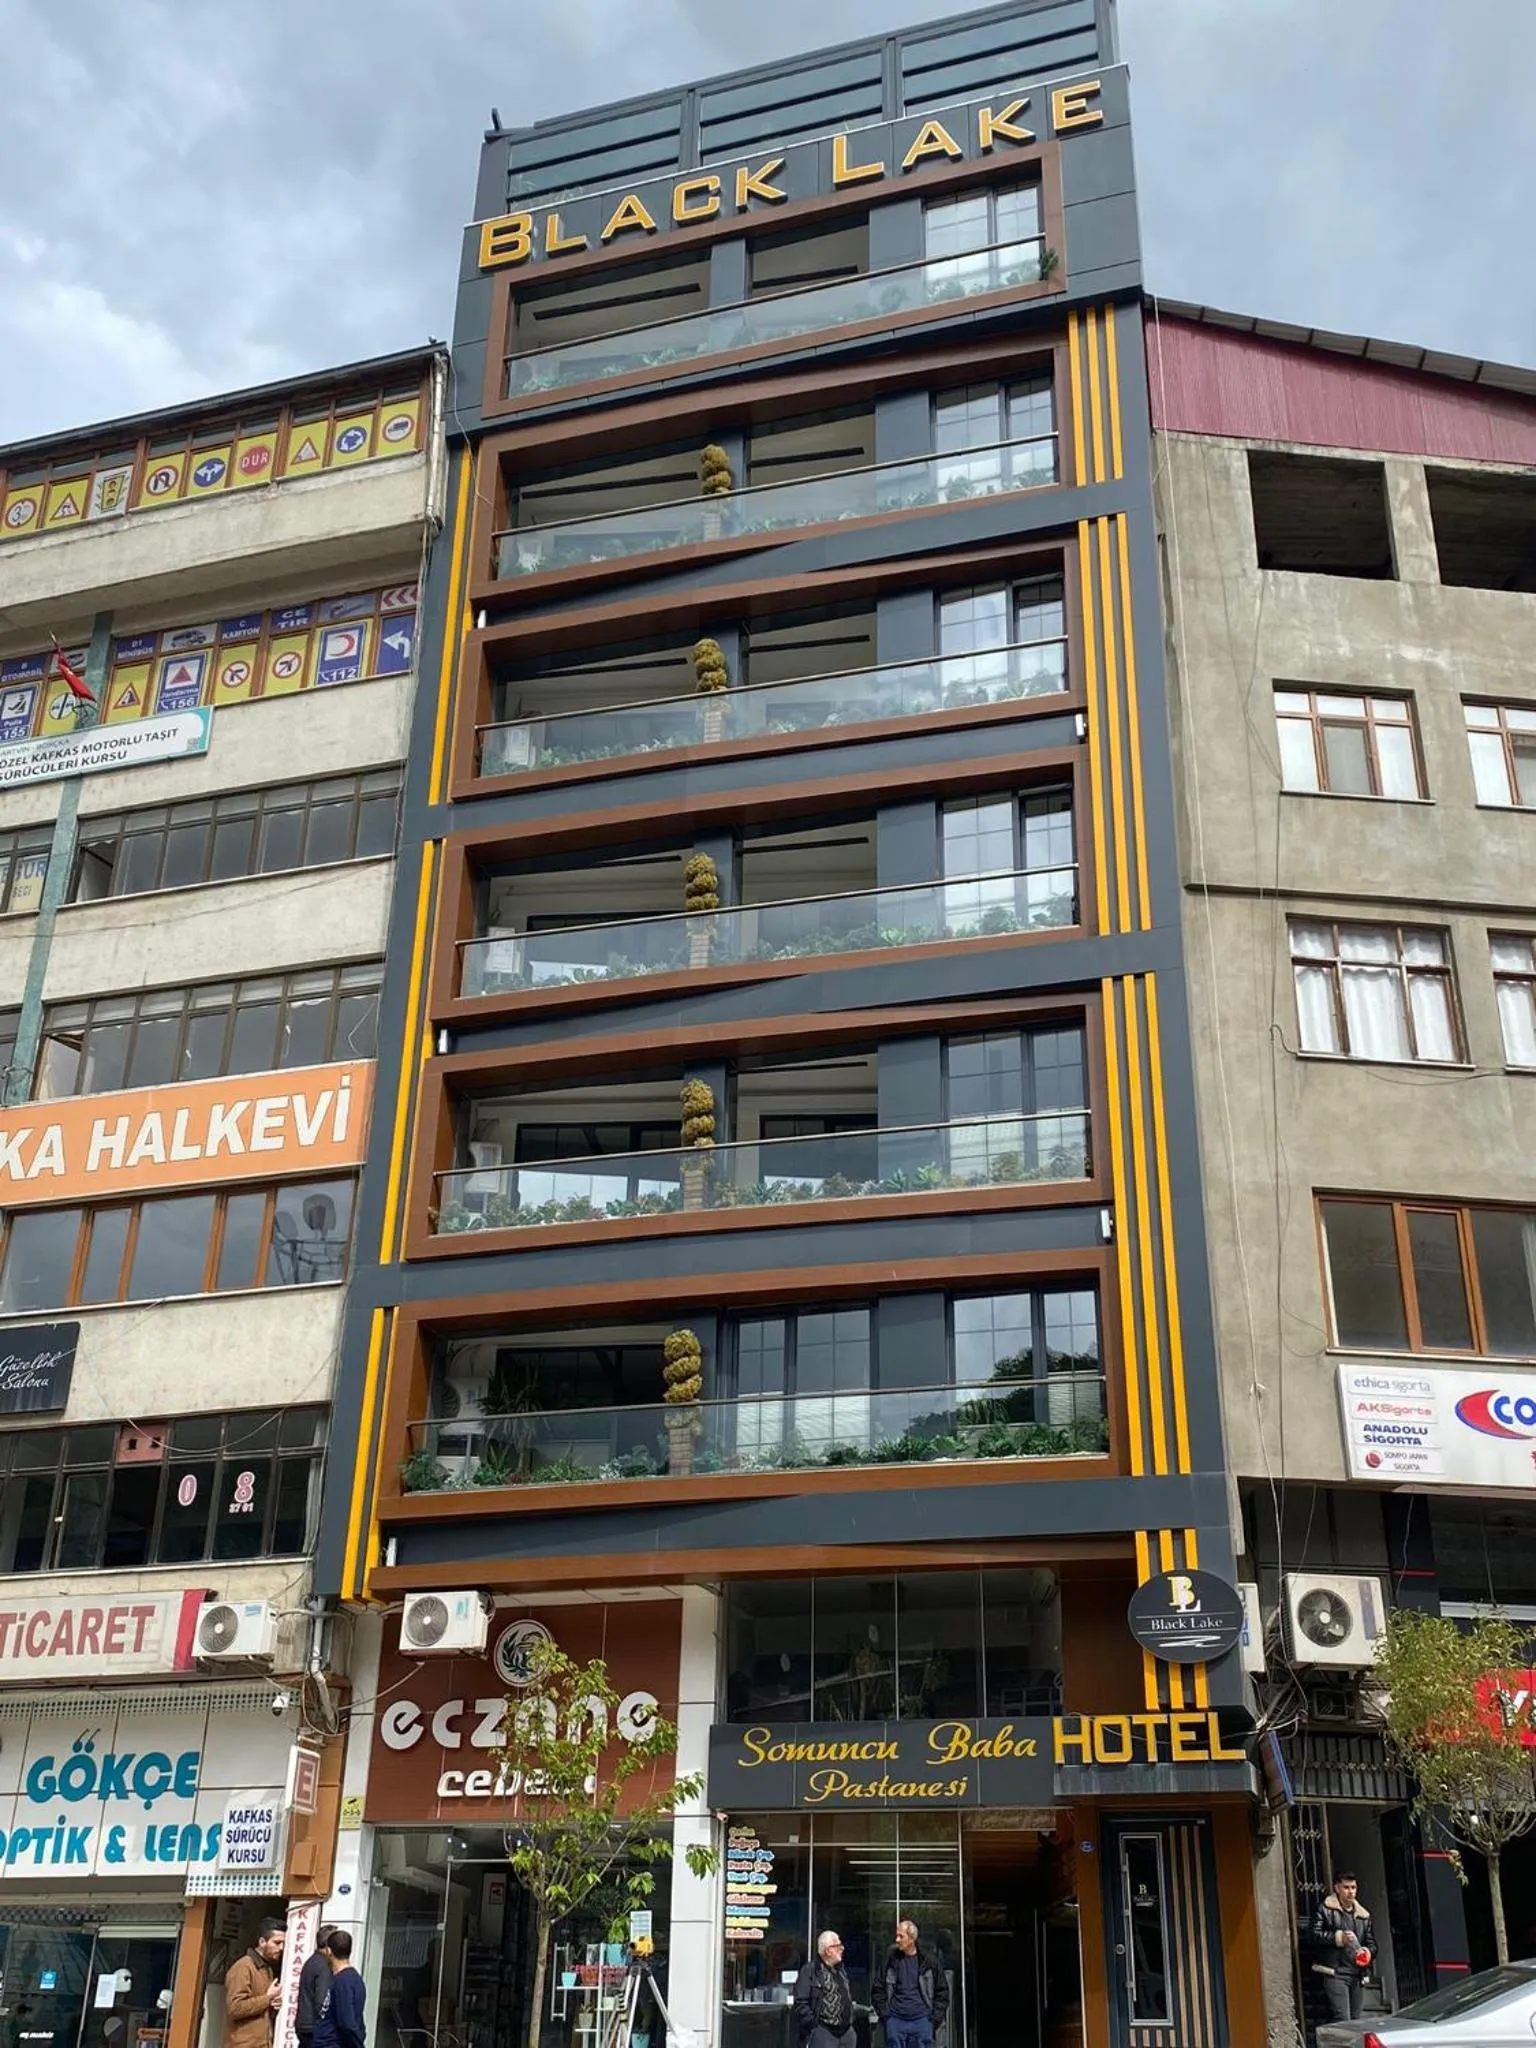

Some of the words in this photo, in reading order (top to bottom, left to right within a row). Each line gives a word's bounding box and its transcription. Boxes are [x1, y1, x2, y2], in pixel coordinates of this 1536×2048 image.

[478, 157, 788, 270] BLACK
[832, 79, 1105, 185] LAKE
[241, 451, 269, 468] DUR
[328, 670, 358, 682] 112
[169, 698, 196, 710] 156
[3, 728, 26, 740] 155
[31, 748, 79, 764] KAFKAS
[82, 736, 143, 755] MOTORLU
[144, 728, 178, 743] TAŞIT
[81, 750, 127, 767] KURSU
[86, 1073, 353, 1172] HALKEVİ
[1354, 1376, 1390, 1390] ethica
[1392, 1381, 1430, 1393] sigorta
[1363, 1424, 1428, 1436] ANADOLU
[1151, 1618, 1188, 1631] Black
[1190, 1617, 1224, 1629] Lake
[738, 1726, 900, 1767] Somuncu
[926, 1722, 1037, 1765] Baba
[1053, 1712, 1247, 1764] HOTEL
[26, 1728, 200, 1810] GÖKÇE
[804, 1769, 968, 1803] Pastanesi
[228, 1808, 273, 1824] KAFKAS
[225, 1825, 271, 1844] SÜRÜCÜ
[104, 1825, 126, 1864] &
[227, 1848, 266, 1863] KURSU
[292, 1907, 309, 1977] KAFKAS
